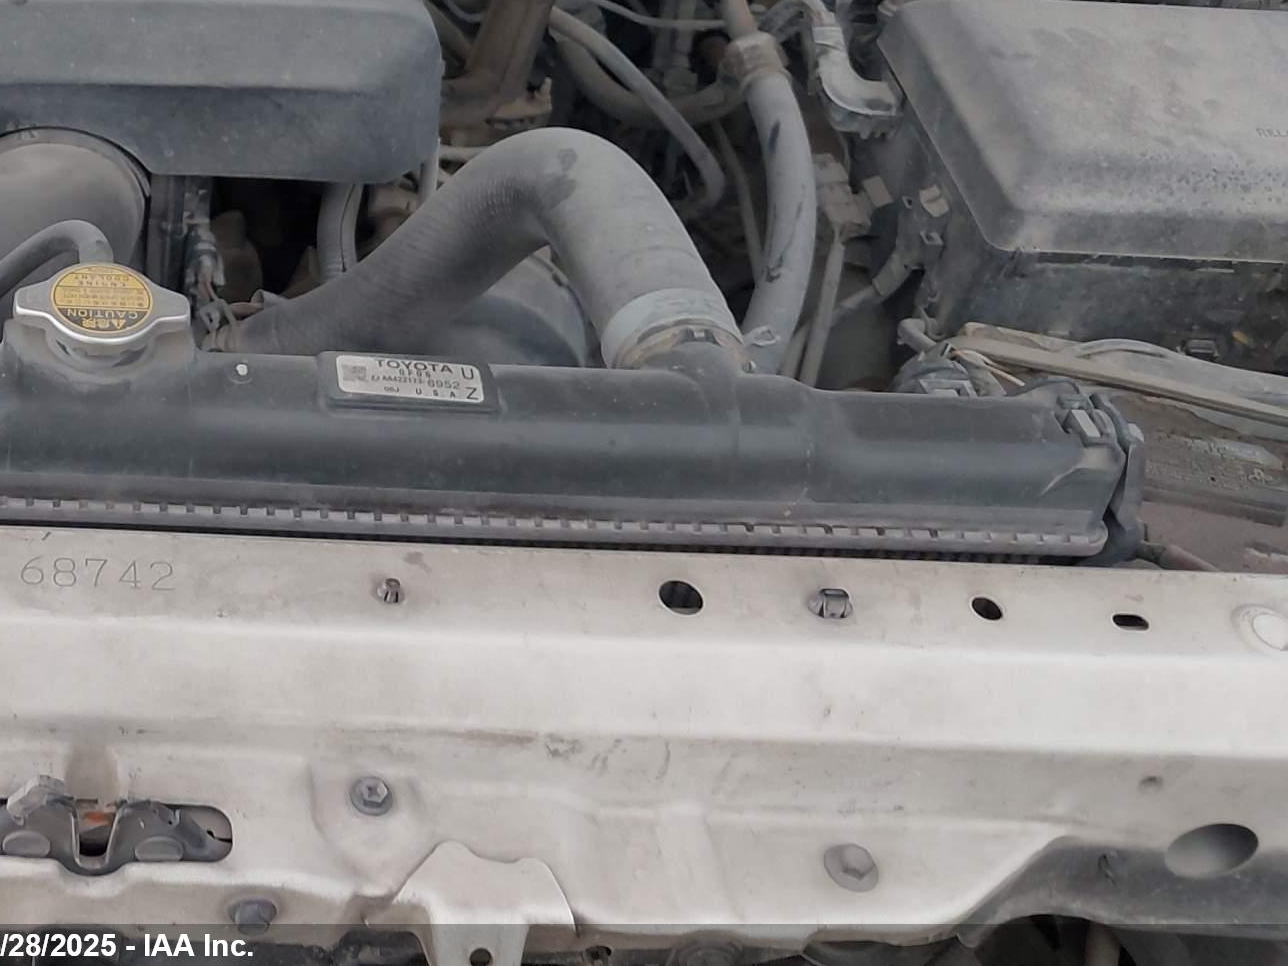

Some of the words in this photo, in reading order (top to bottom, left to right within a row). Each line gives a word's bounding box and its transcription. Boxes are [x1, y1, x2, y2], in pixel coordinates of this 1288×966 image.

[67, 308, 138, 319] CAUTION
[375, 359, 453, 374] TOYOTA
[460, 367, 474, 380] U
[465, 386, 479, 400] Z
[20, 555, 175, 591] 68742
